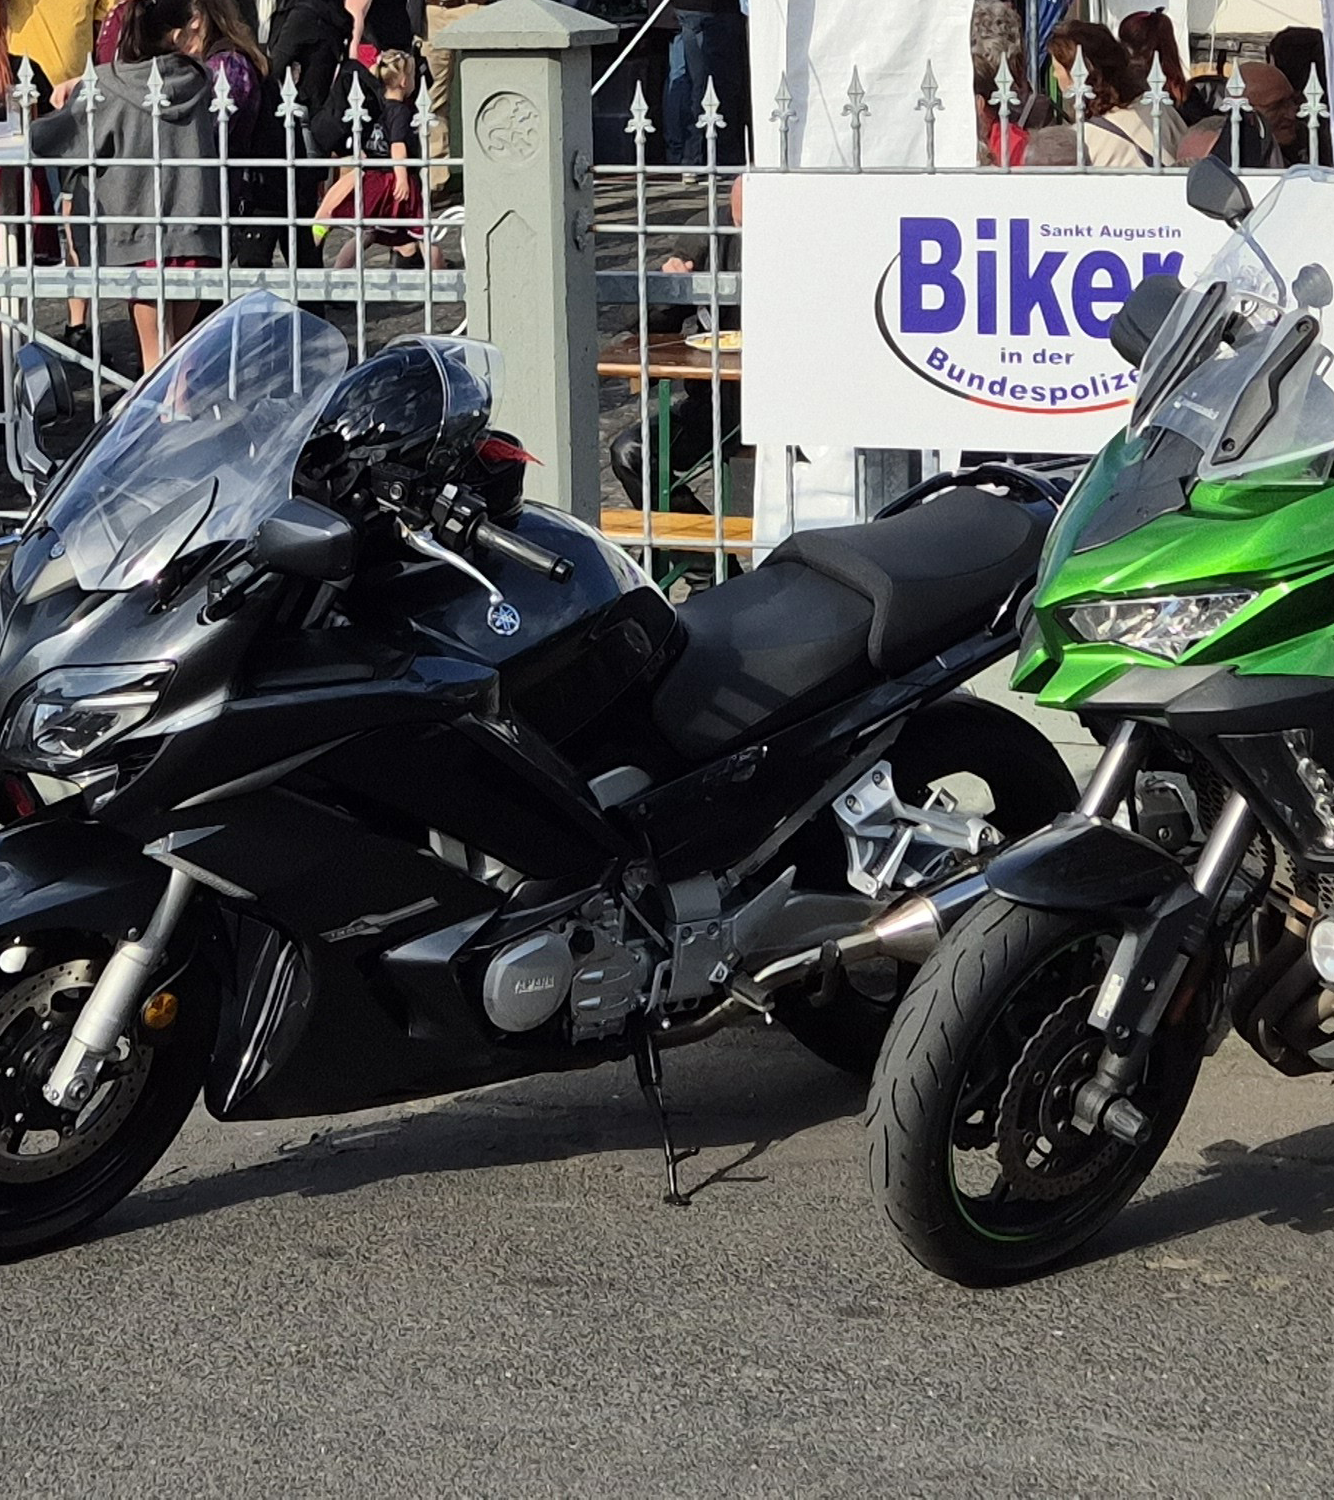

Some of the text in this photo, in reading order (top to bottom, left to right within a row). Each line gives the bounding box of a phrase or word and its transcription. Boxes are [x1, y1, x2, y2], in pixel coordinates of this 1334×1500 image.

[1039, 223, 1182, 241] Sankt Augustin
[1000, 348, 1075, 365] in der
[925, 346, 1140, 406] Bundespolize
